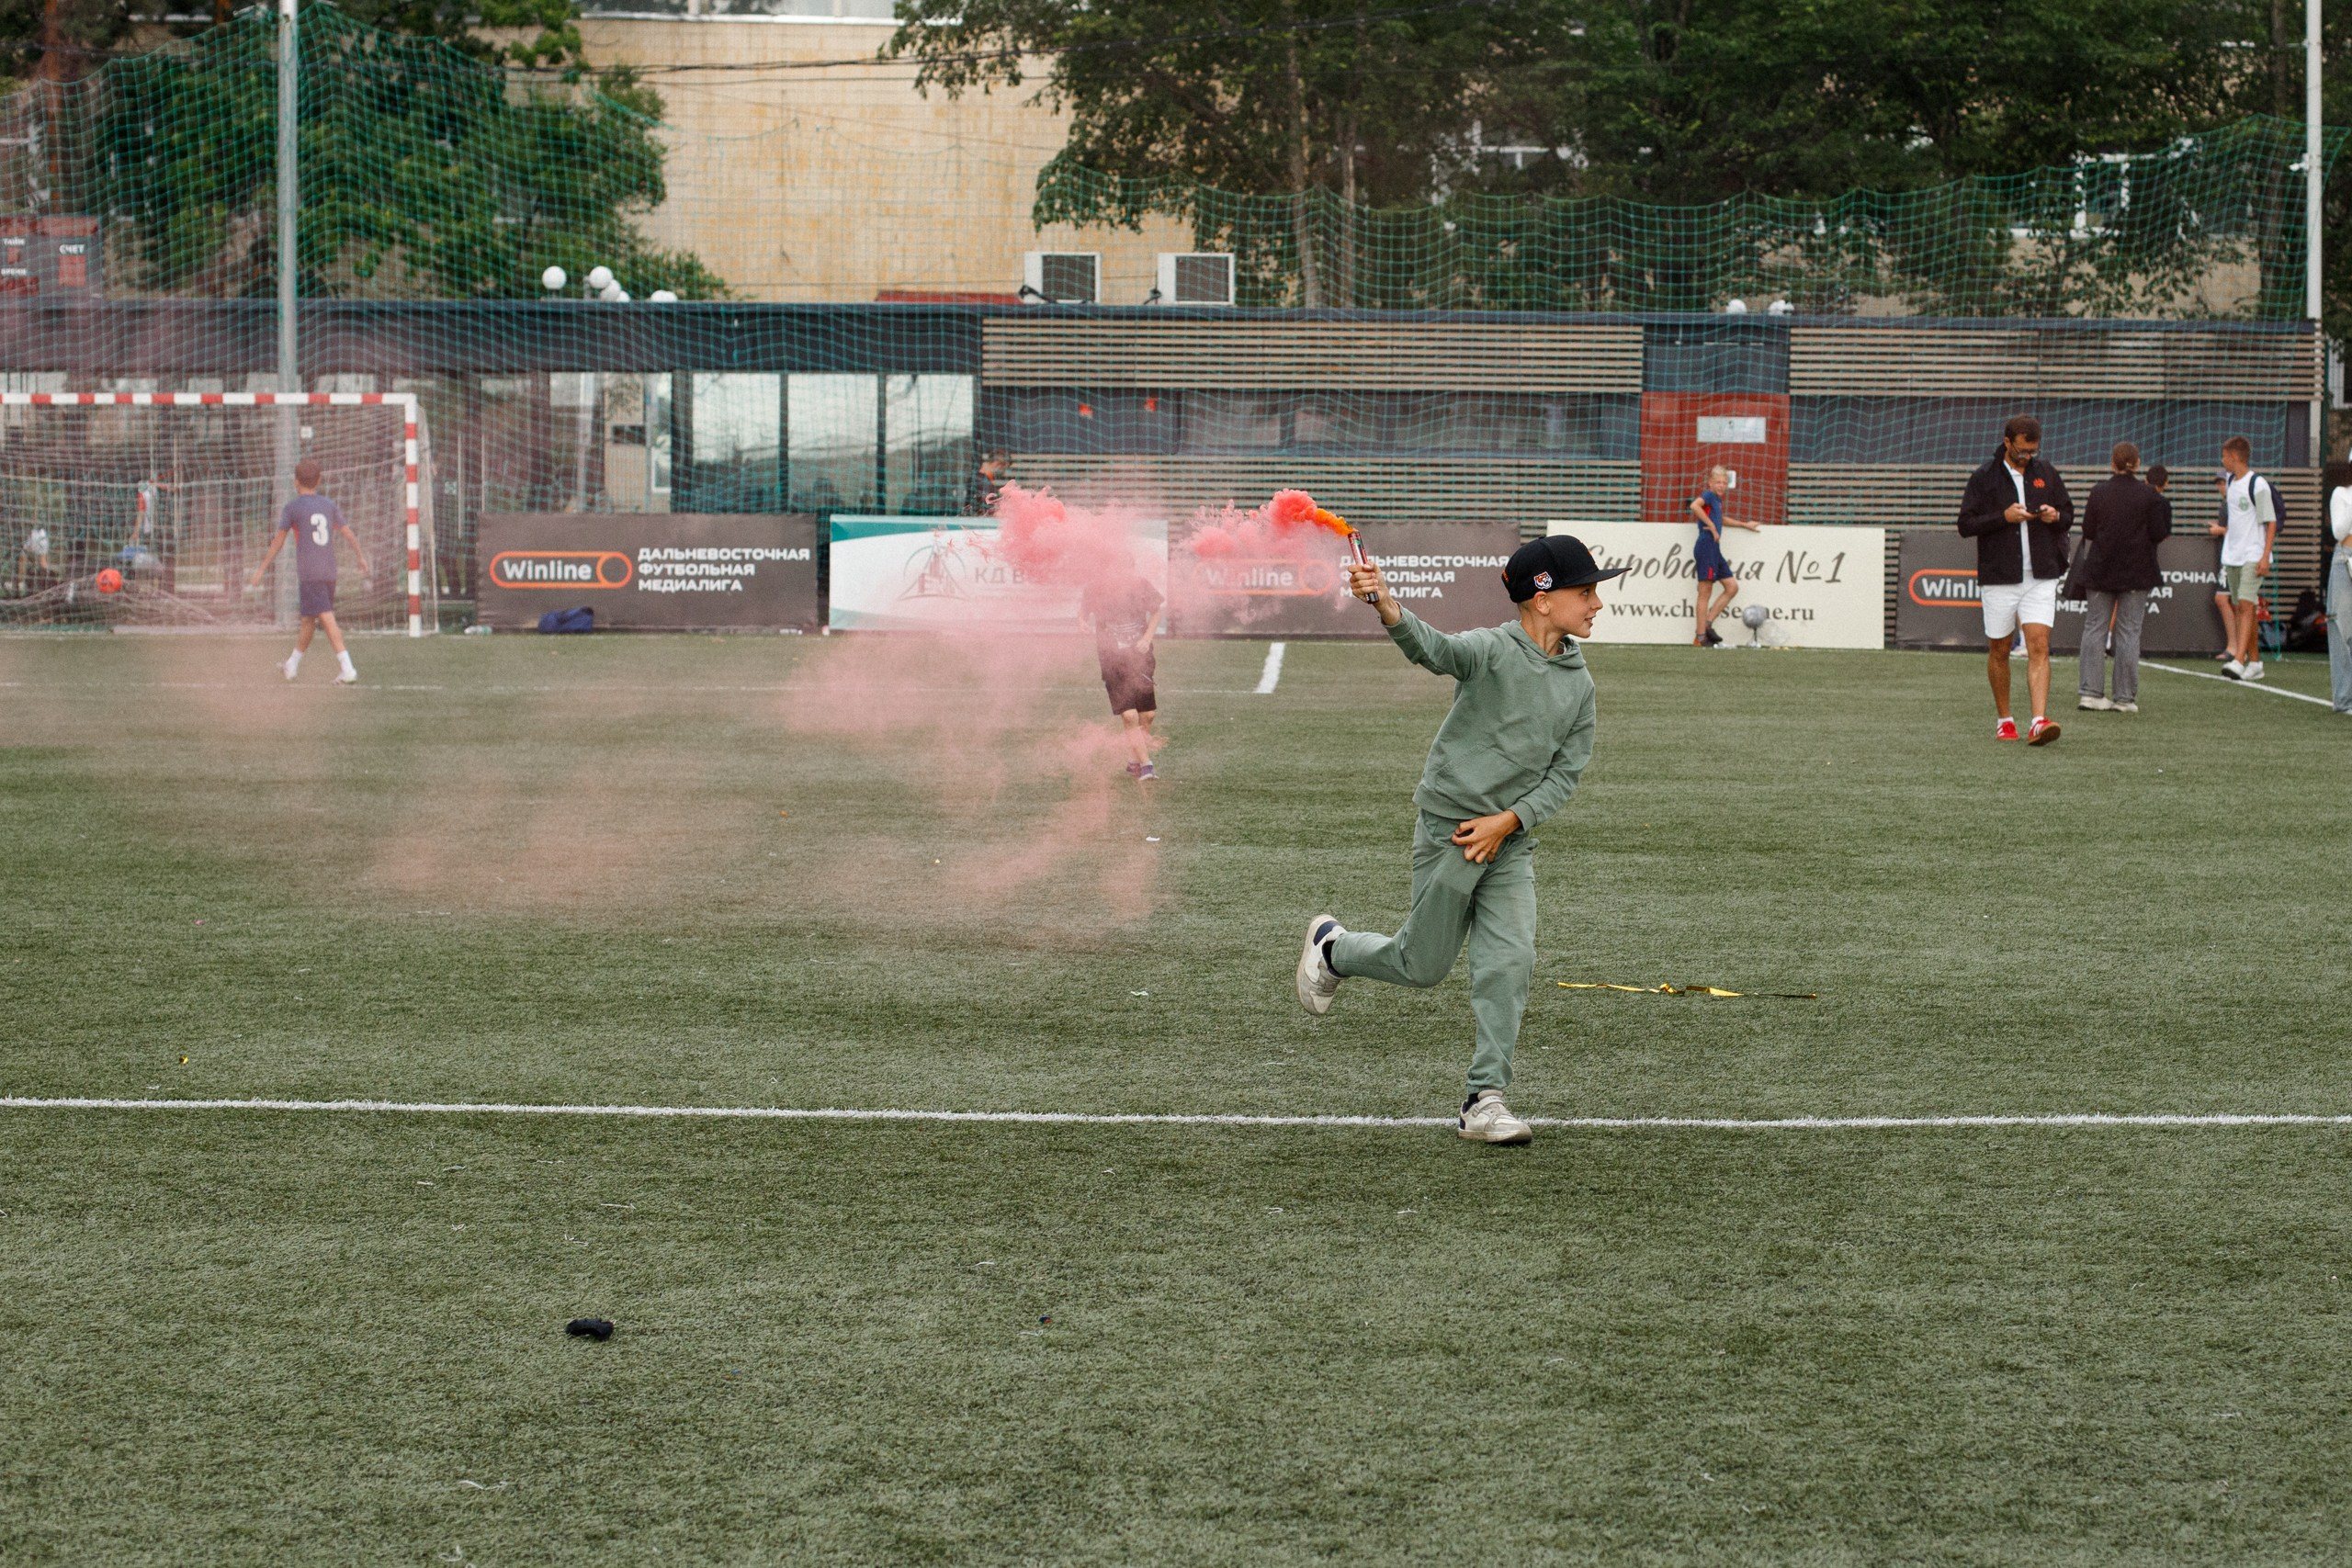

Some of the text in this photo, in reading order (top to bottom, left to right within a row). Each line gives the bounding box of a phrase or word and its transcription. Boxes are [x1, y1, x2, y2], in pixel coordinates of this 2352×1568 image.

[59, 243, 85, 255] СЧЕТ
[310, 513, 329, 547] 3
[638, 547, 810, 562] ДАЛЬНЕВОСТОЧНАЯ
[1339, 555, 1509, 568] ДЛЬНЕВОСТОЧНАЯ
[503, 559, 593, 581] Winline
[638, 562, 755, 577] ФУТБОЛЬНАЯ
[1776, 549, 1846, 584] №1
[1205, 567, 1295, 587] Wnline
[1340, 570, 1455, 583] ФОЛЬНАЯ
[638, 579, 743, 593] МЕДИАЛИГА
[1339, 586, 1443, 599] МАЛИГА
[1921, 578, 1982, 599] Winli
